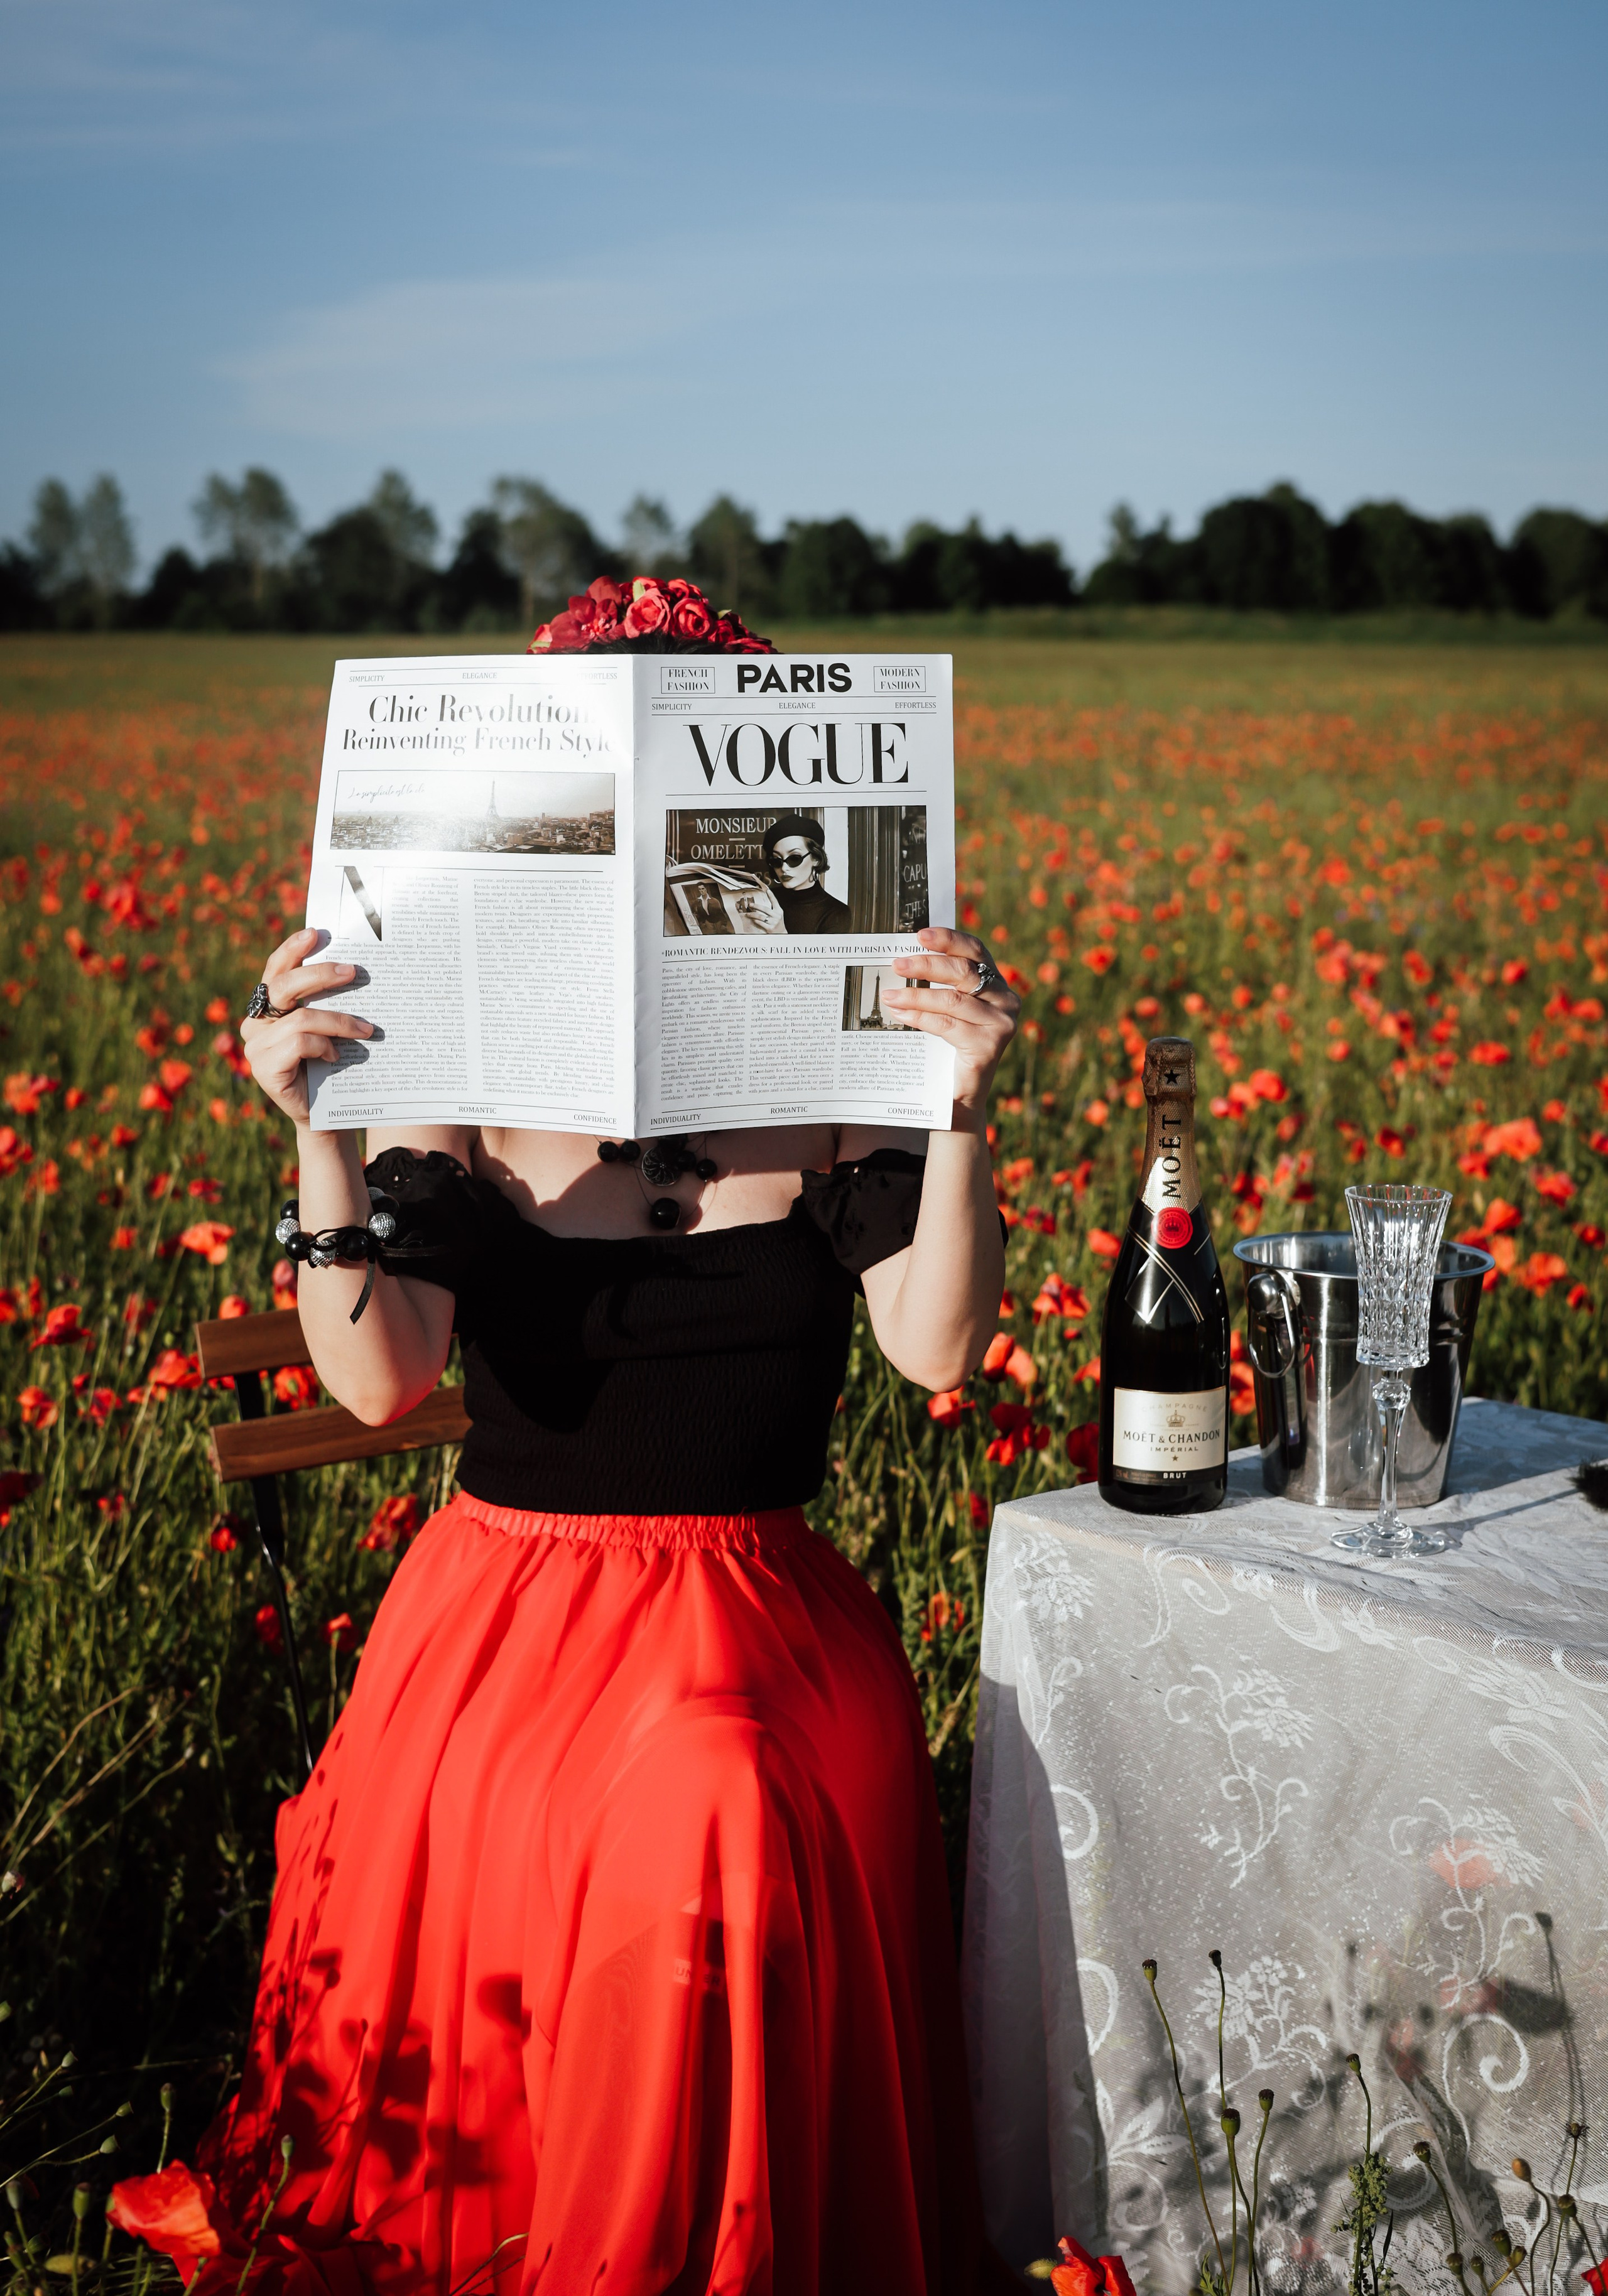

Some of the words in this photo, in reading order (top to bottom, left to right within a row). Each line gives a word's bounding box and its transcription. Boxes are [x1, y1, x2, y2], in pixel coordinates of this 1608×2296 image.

[349, 674, 384, 683] SIMPLICITY
[668, 669, 708, 678] FRENCH
[737, 663, 852, 693] PARIS
[879, 668, 921, 677] MODERN
[667, 682, 710, 691] FASHION
[881, 681, 921, 690] FASHION
[369, 695, 427, 723] Chic
[652, 703, 692, 711] SIMPLICITY
[343, 727, 466, 756] Reinventing
[475, 727, 551, 751] French
[683, 723, 909, 787] VOGUE
[329, 1108, 383, 1117] INDIVIDUALITY
[573, 1114, 617, 1124] CONFIDENCE
[651, 1114, 701, 1125] INDIVIDUALITY
[888, 1107, 934, 1117] CONFIDENCE
[1159, 1114, 1181, 1199] MOËT
[1123, 1430, 1156, 1443] MOËT
[1168, 1429, 1220, 1443] CHANDON
